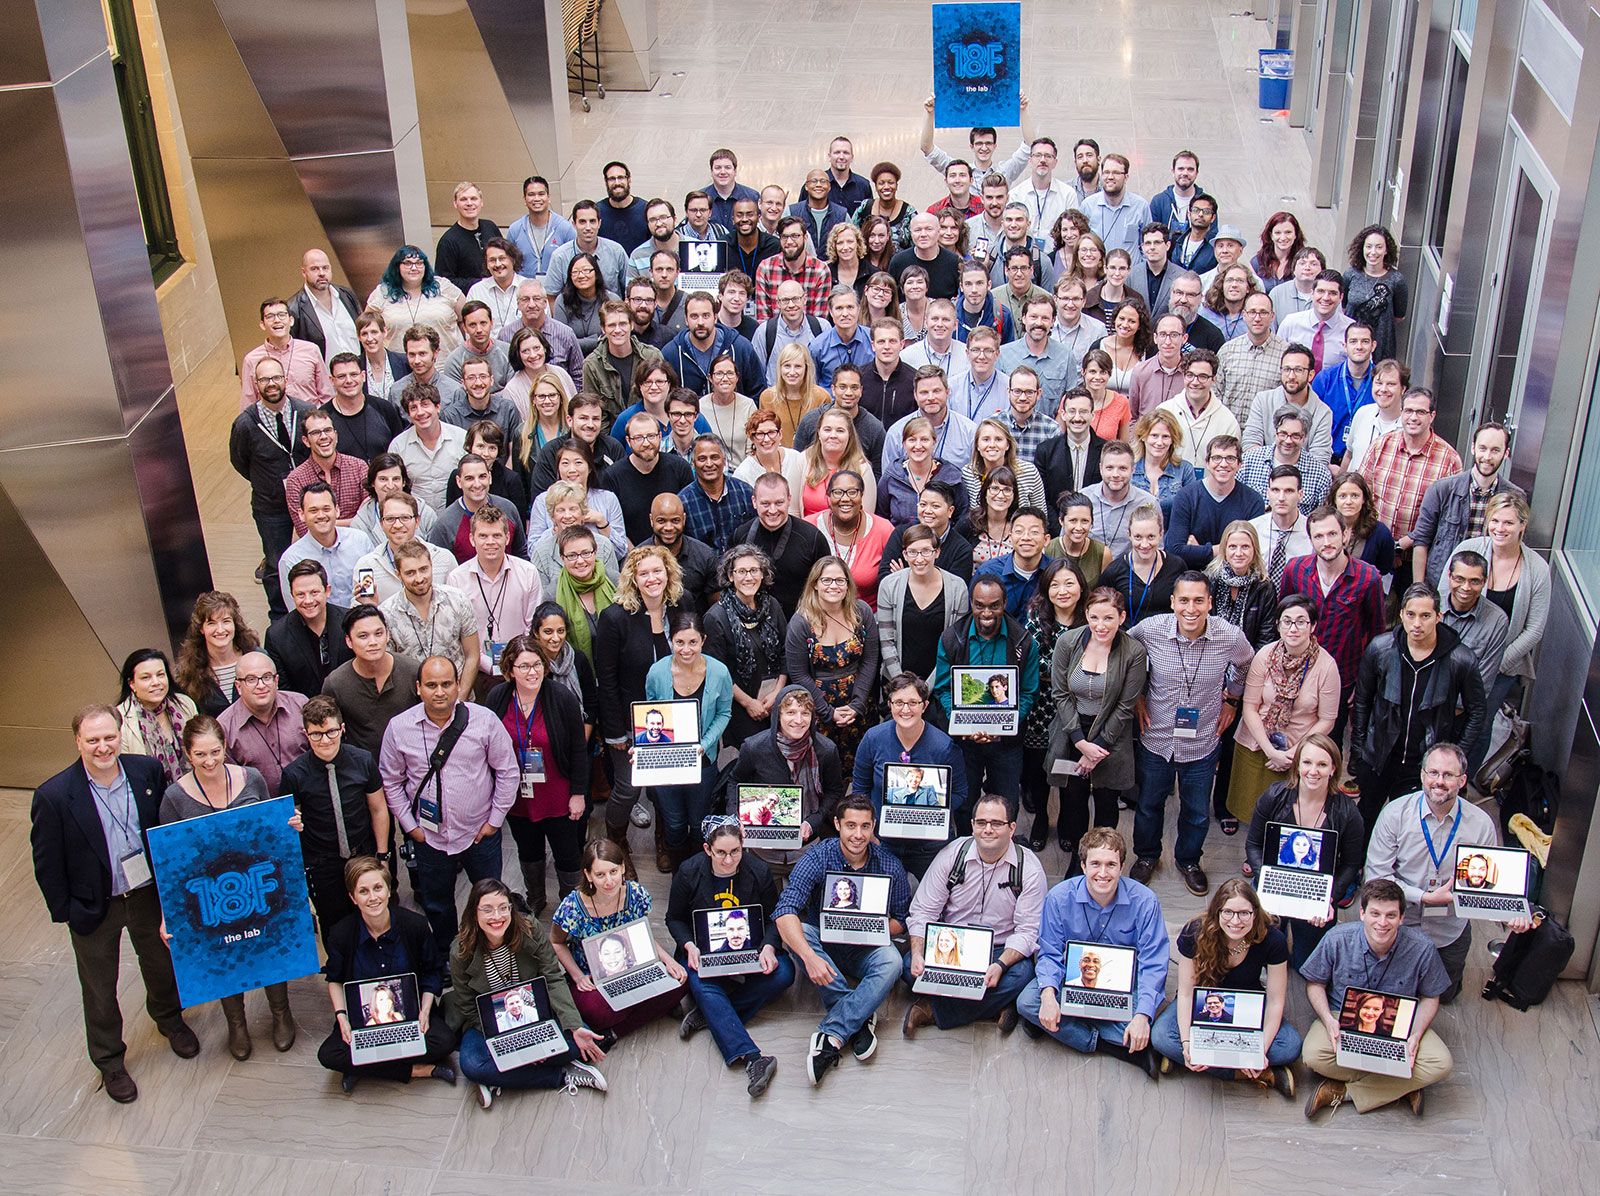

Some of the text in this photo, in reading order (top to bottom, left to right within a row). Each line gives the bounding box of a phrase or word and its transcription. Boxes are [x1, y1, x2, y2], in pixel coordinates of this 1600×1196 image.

[948, 42, 1004, 79] 18F
[185, 860, 279, 928] 18F
[224, 928, 261, 944] the lab
